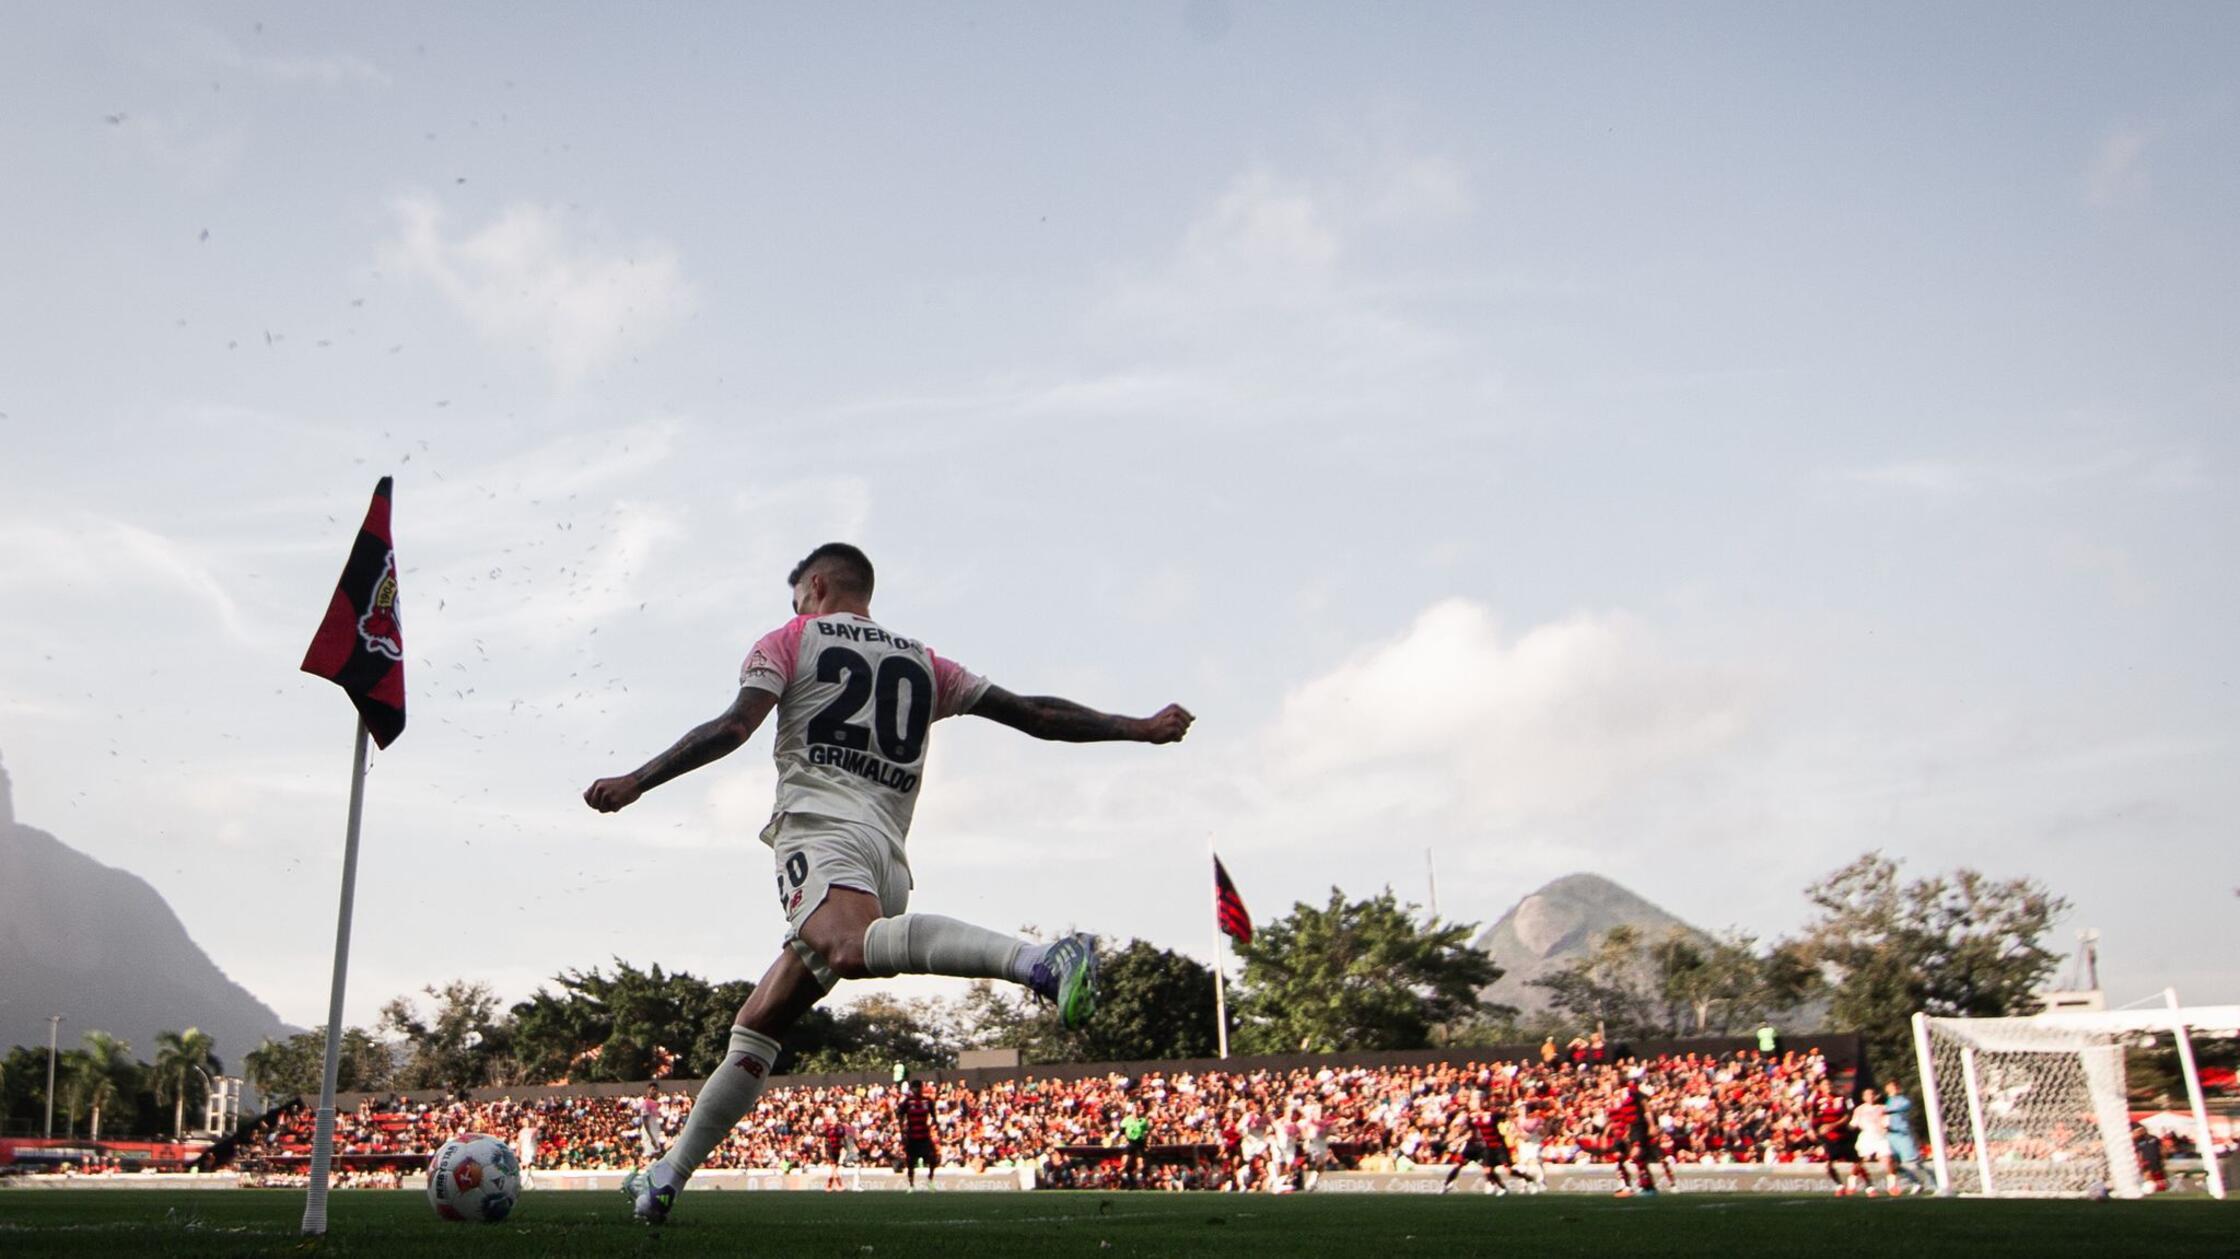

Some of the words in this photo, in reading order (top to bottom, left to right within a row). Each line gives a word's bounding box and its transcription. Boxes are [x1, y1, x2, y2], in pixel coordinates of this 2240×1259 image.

[379, 579, 396, 604] 1904
[806, 646, 933, 764] 20
[808, 745, 918, 795] GRIMALDO
